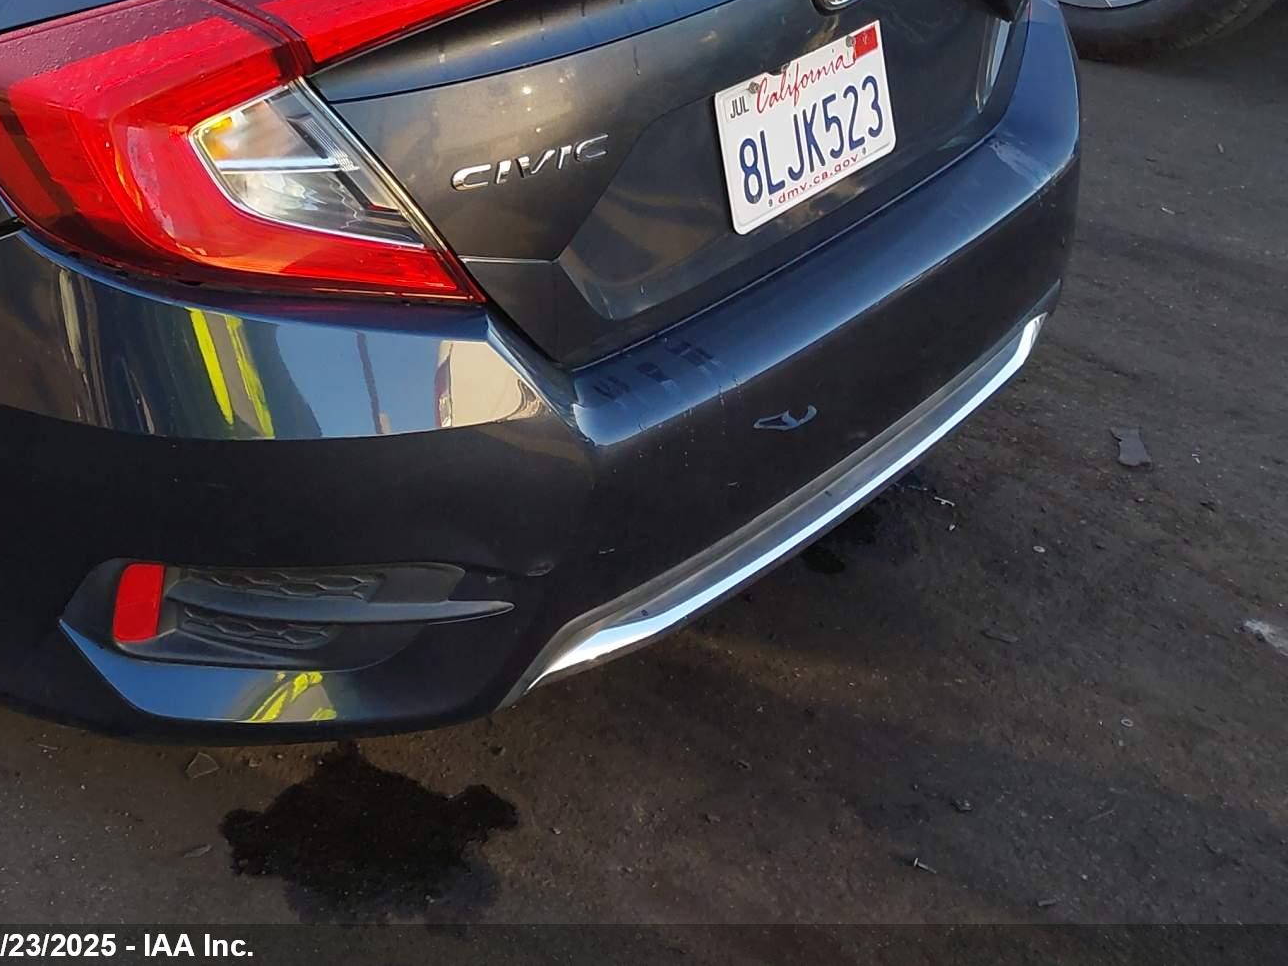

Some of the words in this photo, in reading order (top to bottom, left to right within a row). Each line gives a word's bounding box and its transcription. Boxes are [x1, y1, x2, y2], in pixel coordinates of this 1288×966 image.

[730, 95, 749, 119] JUL
[755, 48, 856, 114] California
[451, 133, 609, 192] CIVIC
[739, 75, 884, 205] 8LJK523
[778, 152, 859, 205] dmv.ca.gov
